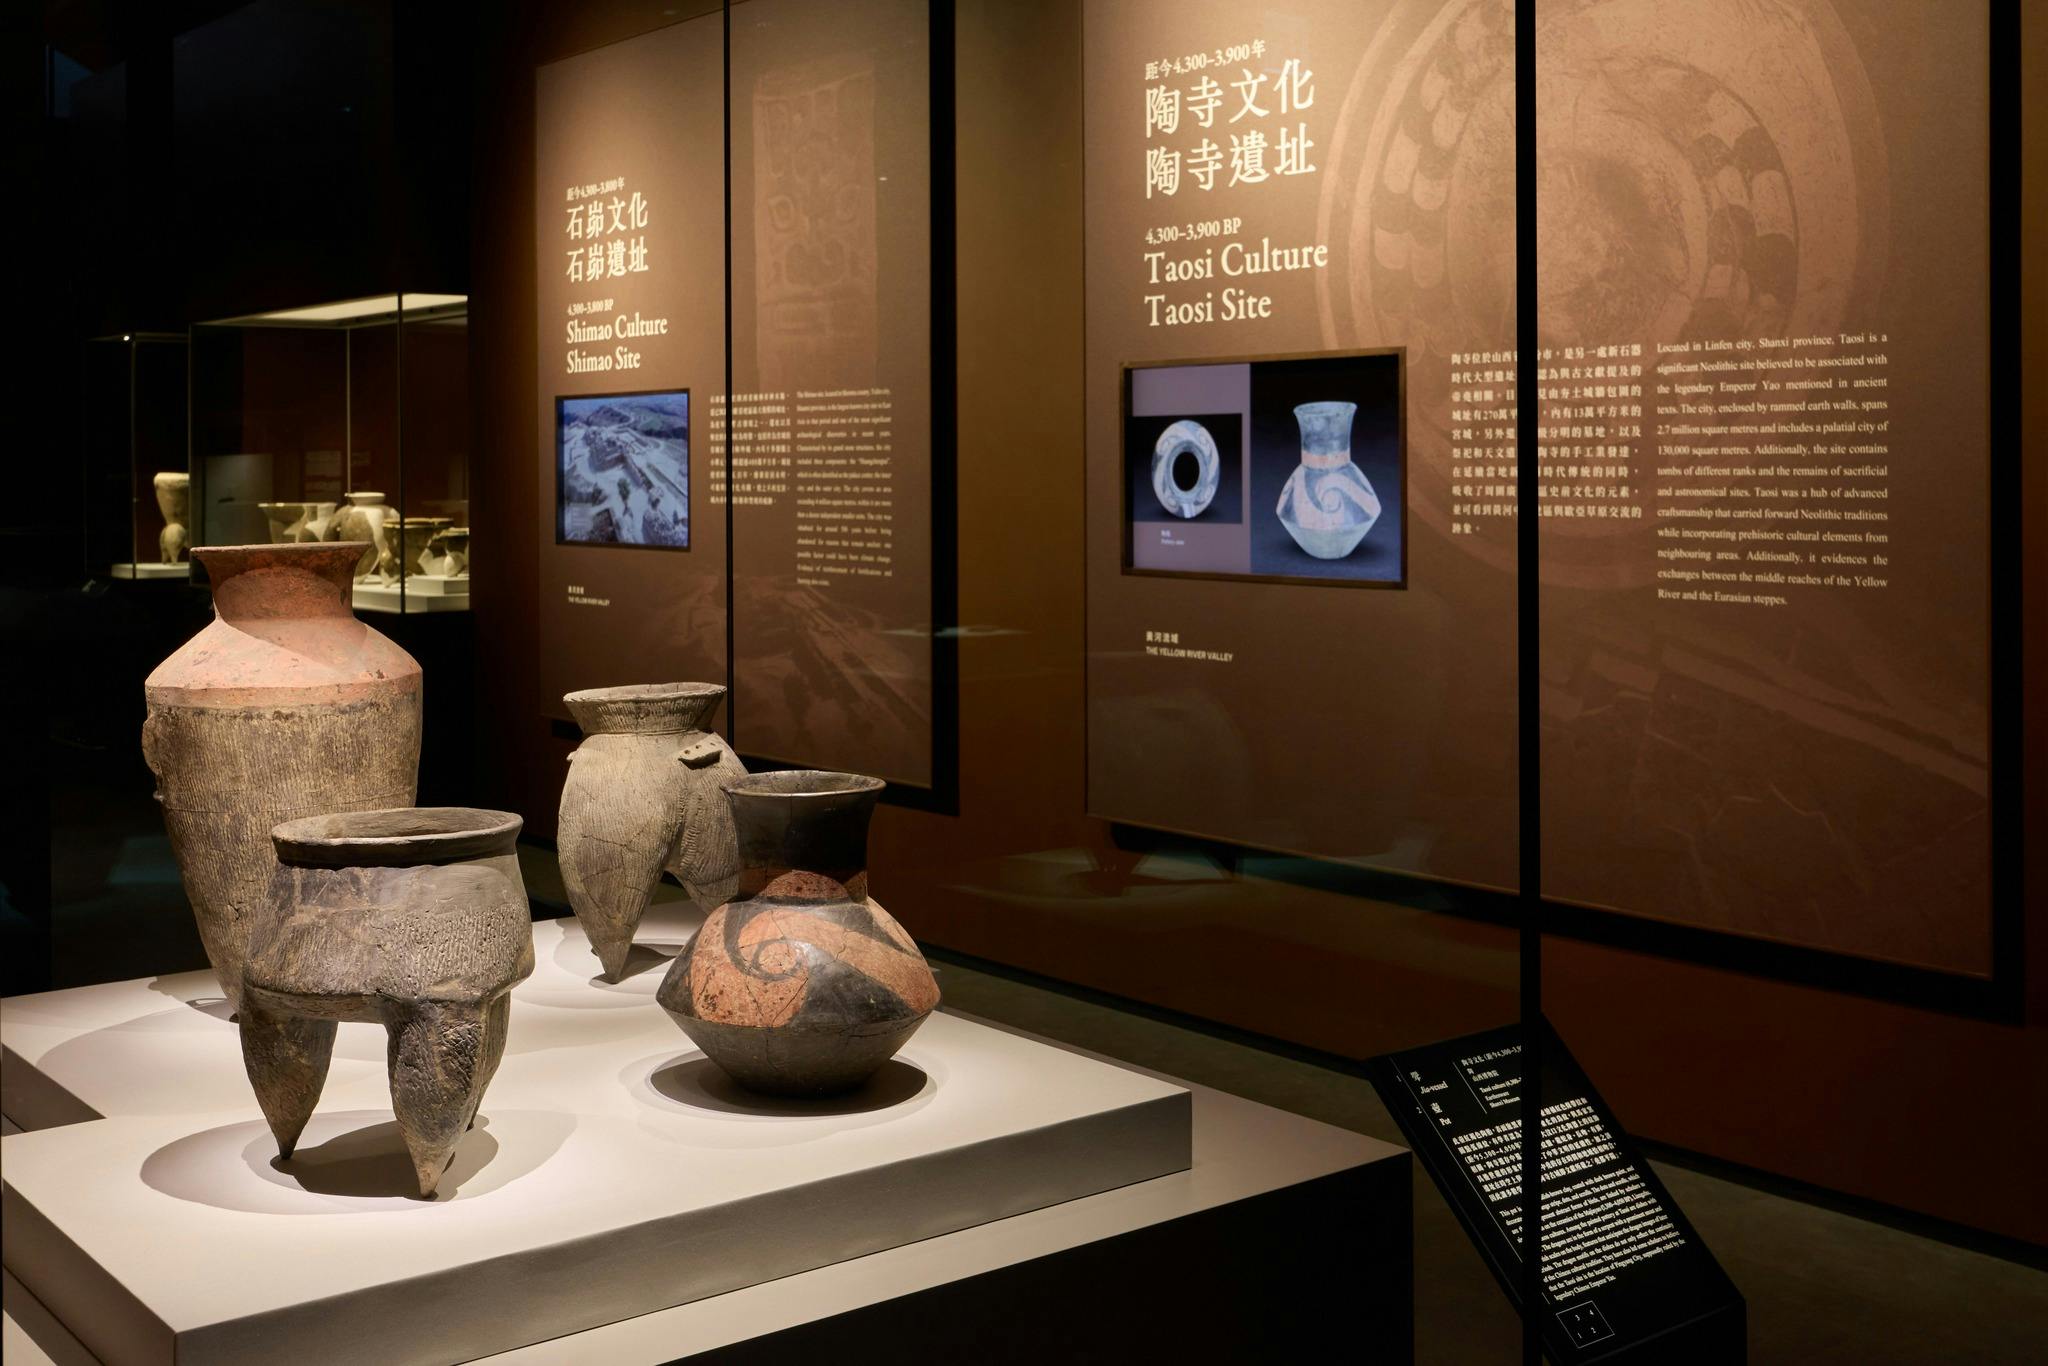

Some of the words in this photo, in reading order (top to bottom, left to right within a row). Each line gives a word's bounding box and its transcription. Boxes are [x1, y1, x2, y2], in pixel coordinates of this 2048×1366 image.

[1145, 58, 1315, 138] 陶寺文化
[1145, 122, 1317, 199] 陶寺遺址
[566, 191, 649, 241] 石峁文化
[1222, 217, 1242, 236] BP
[566, 236, 649, 283] 石峁遺址
[1144, 248, 1214, 284] Taosi
[1220, 236, 1329, 277] Culture
[1144, 292, 1214, 326] Taosi
[1221, 287, 1272, 321] Site
[566, 319, 613, 344] Shimao
[615, 311, 668, 339] Culture
[1656, 341, 1690, 353] Located
[1692, 340, 1701, 351] in
[1704, 339, 1733, 350] Linfen
[1758, 336, 1789, 348] Shanxi
[1840, 332, 1865, 344] Taosi
[1868, 332, 1877, 342] is
[566, 348, 613, 374] Shimao
[615, 346, 641, 370] Site
[1656, 361, 1699, 376] significant
[1699, 360, 1738, 371] Neolithic
[1739, 359, 1755, 370] site
[1755, 357, 1793, 369] believed
[1794, 359, 1804, 367] to
[1804, 356, 1816, 367] be
[1817, 354, 1864, 367] associated
[1866, 353, 1887, 364] with
[1656, 383, 1670, 394] the
[1674, 382, 1714, 396] legendary
[1719, 380, 1756, 394] Emperor
[1762, 379, 1780, 390] Yao
[1785, 377, 1832, 389] mentioned
[1838, 377, 1848, 387] in
[1853, 376, 1887, 387] ancient
[1681, 402, 1697, 414] The
[1718, 401, 1755, 413] enclosed
[1756, 401, 1768, 414] by
[1769, 400, 1806, 411] rammed
[1807, 399, 1830, 410] earth
[1860, 400, 1888, 411] spans
[1656, 424, 1670, 435] 2.7
[1670, 423, 1700, 434] million
[1701, 425, 1728, 436] square
[1729, 424, 1759, 434] metres
[1759, 422, 1776, 433] and
[1777, 422, 1814, 432] includes
[1822, 421, 1856, 434] palatial
[1857, 421, 1875, 433] city
[1876, 420, 1888, 431] of
[1691, 446, 1719, 456] square
[1812, 443, 1828, 454] the
[1829, 443, 1846, 454] site
[1848, 443, 1888, 453] contains
[1656, 465, 1682, 475] tombs
[1683, 465, 1694, 475] of
[1694, 465, 1731, 475] different
[1732, 465, 1756, 475] ranks
[1757, 465, 1774, 475] and
[1776, 465, 1790, 476] the
[1792, 465, 1828, 475] remains
[1830, 465, 1841, 475] of
[1842, 465, 1888, 476] sacrificial
[1656, 486, 1672, 496] and
[1674, 486, 1727, 496] astronomical
[1755, 486, 1778, 497] Taosi
[1780, 489, 1799, 497] was
[1810, 487, 1828, 497] hub
[1830, 487, 1841, 497] of
[1843, 487, 1888, 498] advanced
[1656, 506, 1714, 519] craftsmanship
[1714, 507, 1731, 517] that
[1732, 507, 1762, 518] carried
[1764, 508, 1799, 519] forward
[1800, 508, 1842, 519] Neolithic
[1843, 509, 1888, 520] traditions
[1657, 527, 1680, 537] while
[1681, 528, 1737, 541] incorporating
[1738, 528, 1784, 541] prehistoric
[1786, 529, 1820, 541] cultural
[1821, 530, 1863, 542] elements
[1864, 531, 1888, 542] from
[1657, 547, 1712, 561] neighbouring
[1808, 552, 1816, 562] it
[1820, 552, 1867, 564] evidences
[1872, 554, 1888, 565] the
[1656, 568, 1700, 581] exchanges
[1701, 570, 1737, 581] between
[1738, 571, 1753, 581] the
[1754, 571, 1785, 583] middle
[1787, 573, 1821, 584] reaches
[1823, 574, 1835, 585] of
[1836, 575, 1851, 586] the
[1854, 575, 1887, 587] Yellow
[1657, 588, 1680, 599] River
[1681, 589, 1698, 600] and
[1698, 590, 1712, 600] the
[1713, 591, 1752, 603] Eurasian
[1159, 646, 1186, 658] YELLOW
[1186, 649, 1206, 660] RIVER
[1206, 651, 1234, 663] VALLEY
